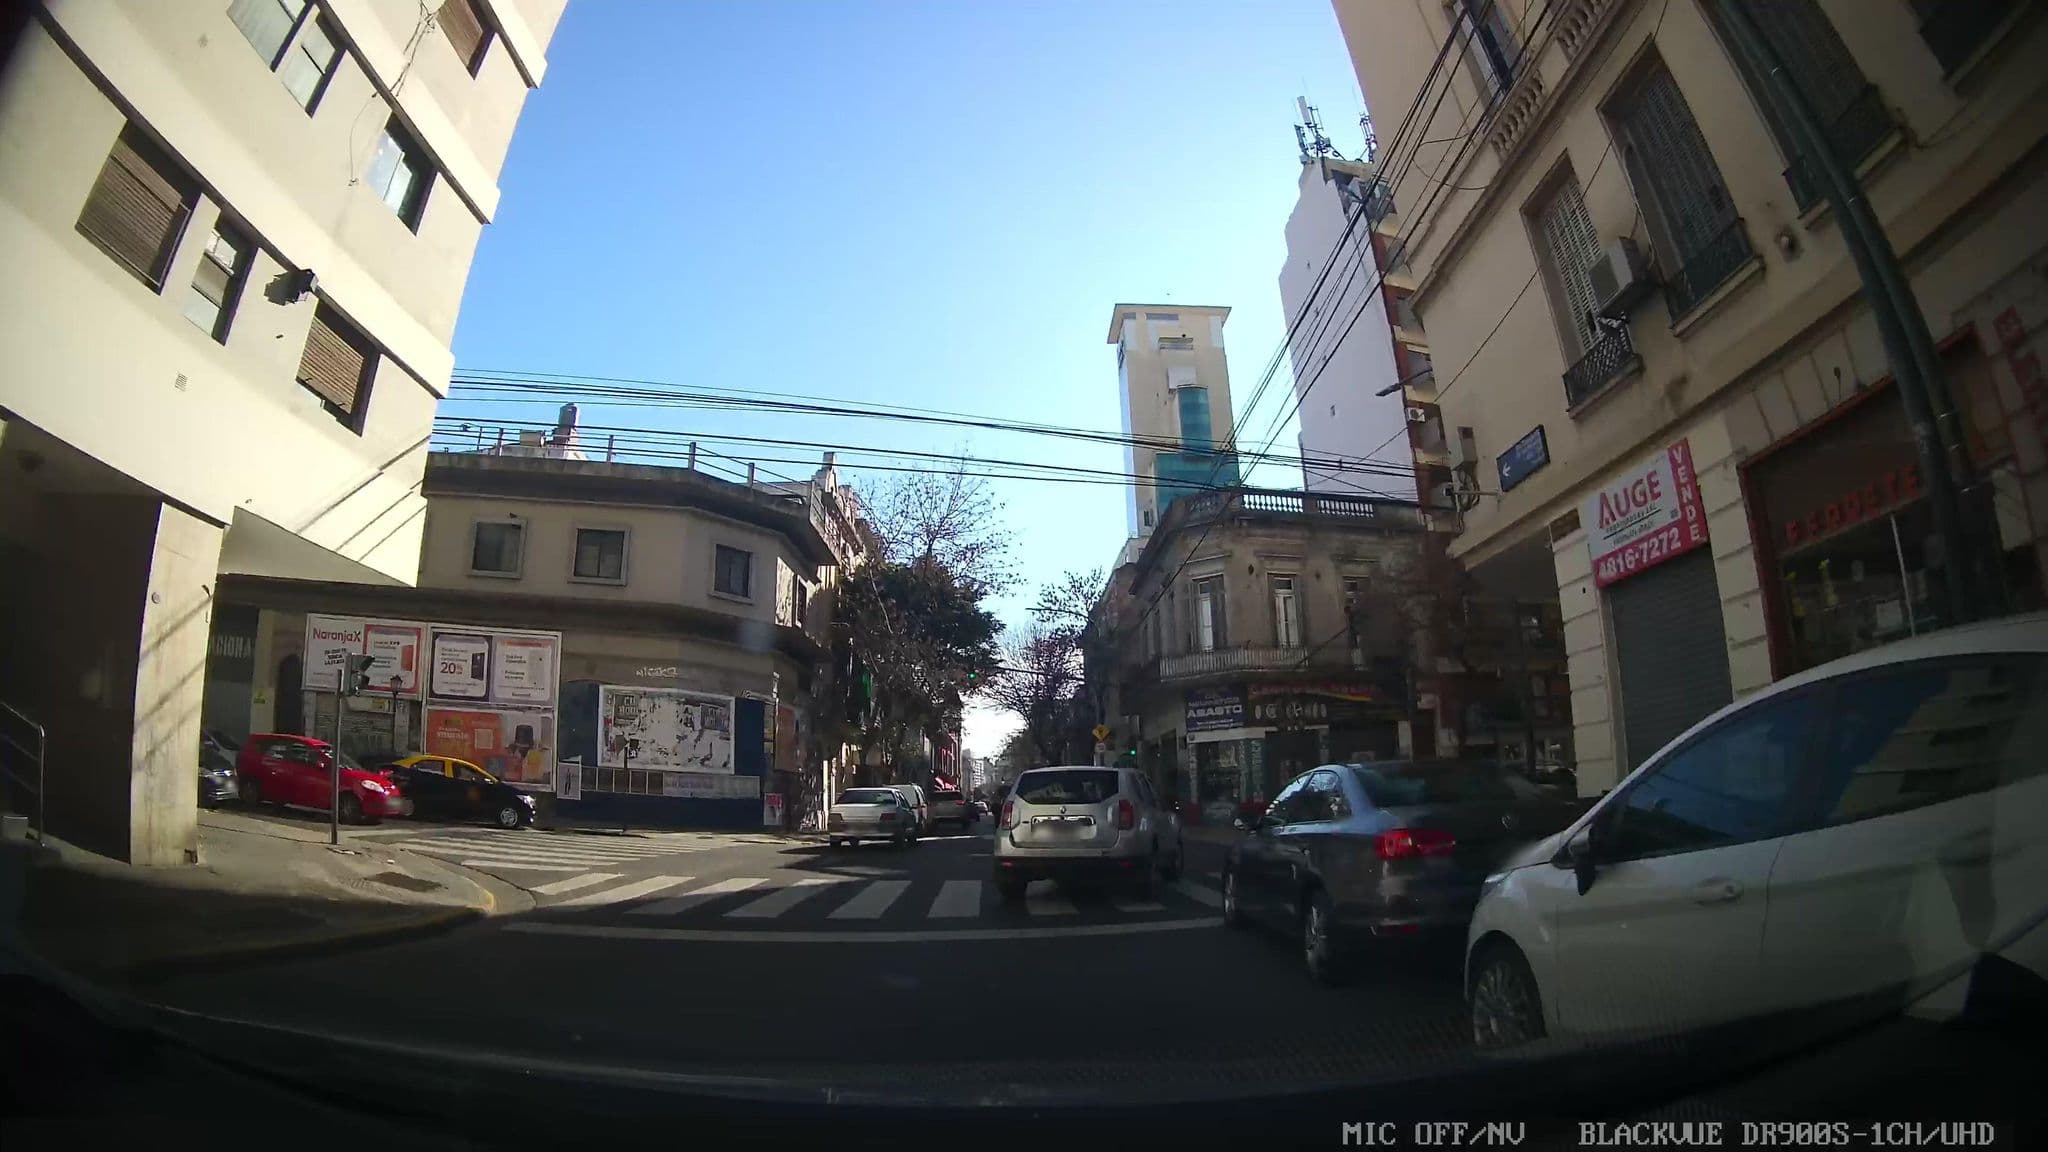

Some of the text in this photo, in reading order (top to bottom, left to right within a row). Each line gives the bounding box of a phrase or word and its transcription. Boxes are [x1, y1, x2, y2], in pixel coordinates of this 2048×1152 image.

[1599, 469, 1662, 529] AUGE
[1672, 445, 1701, 542] VENDE
[1186, 703, 1243, 719] ABASTO
